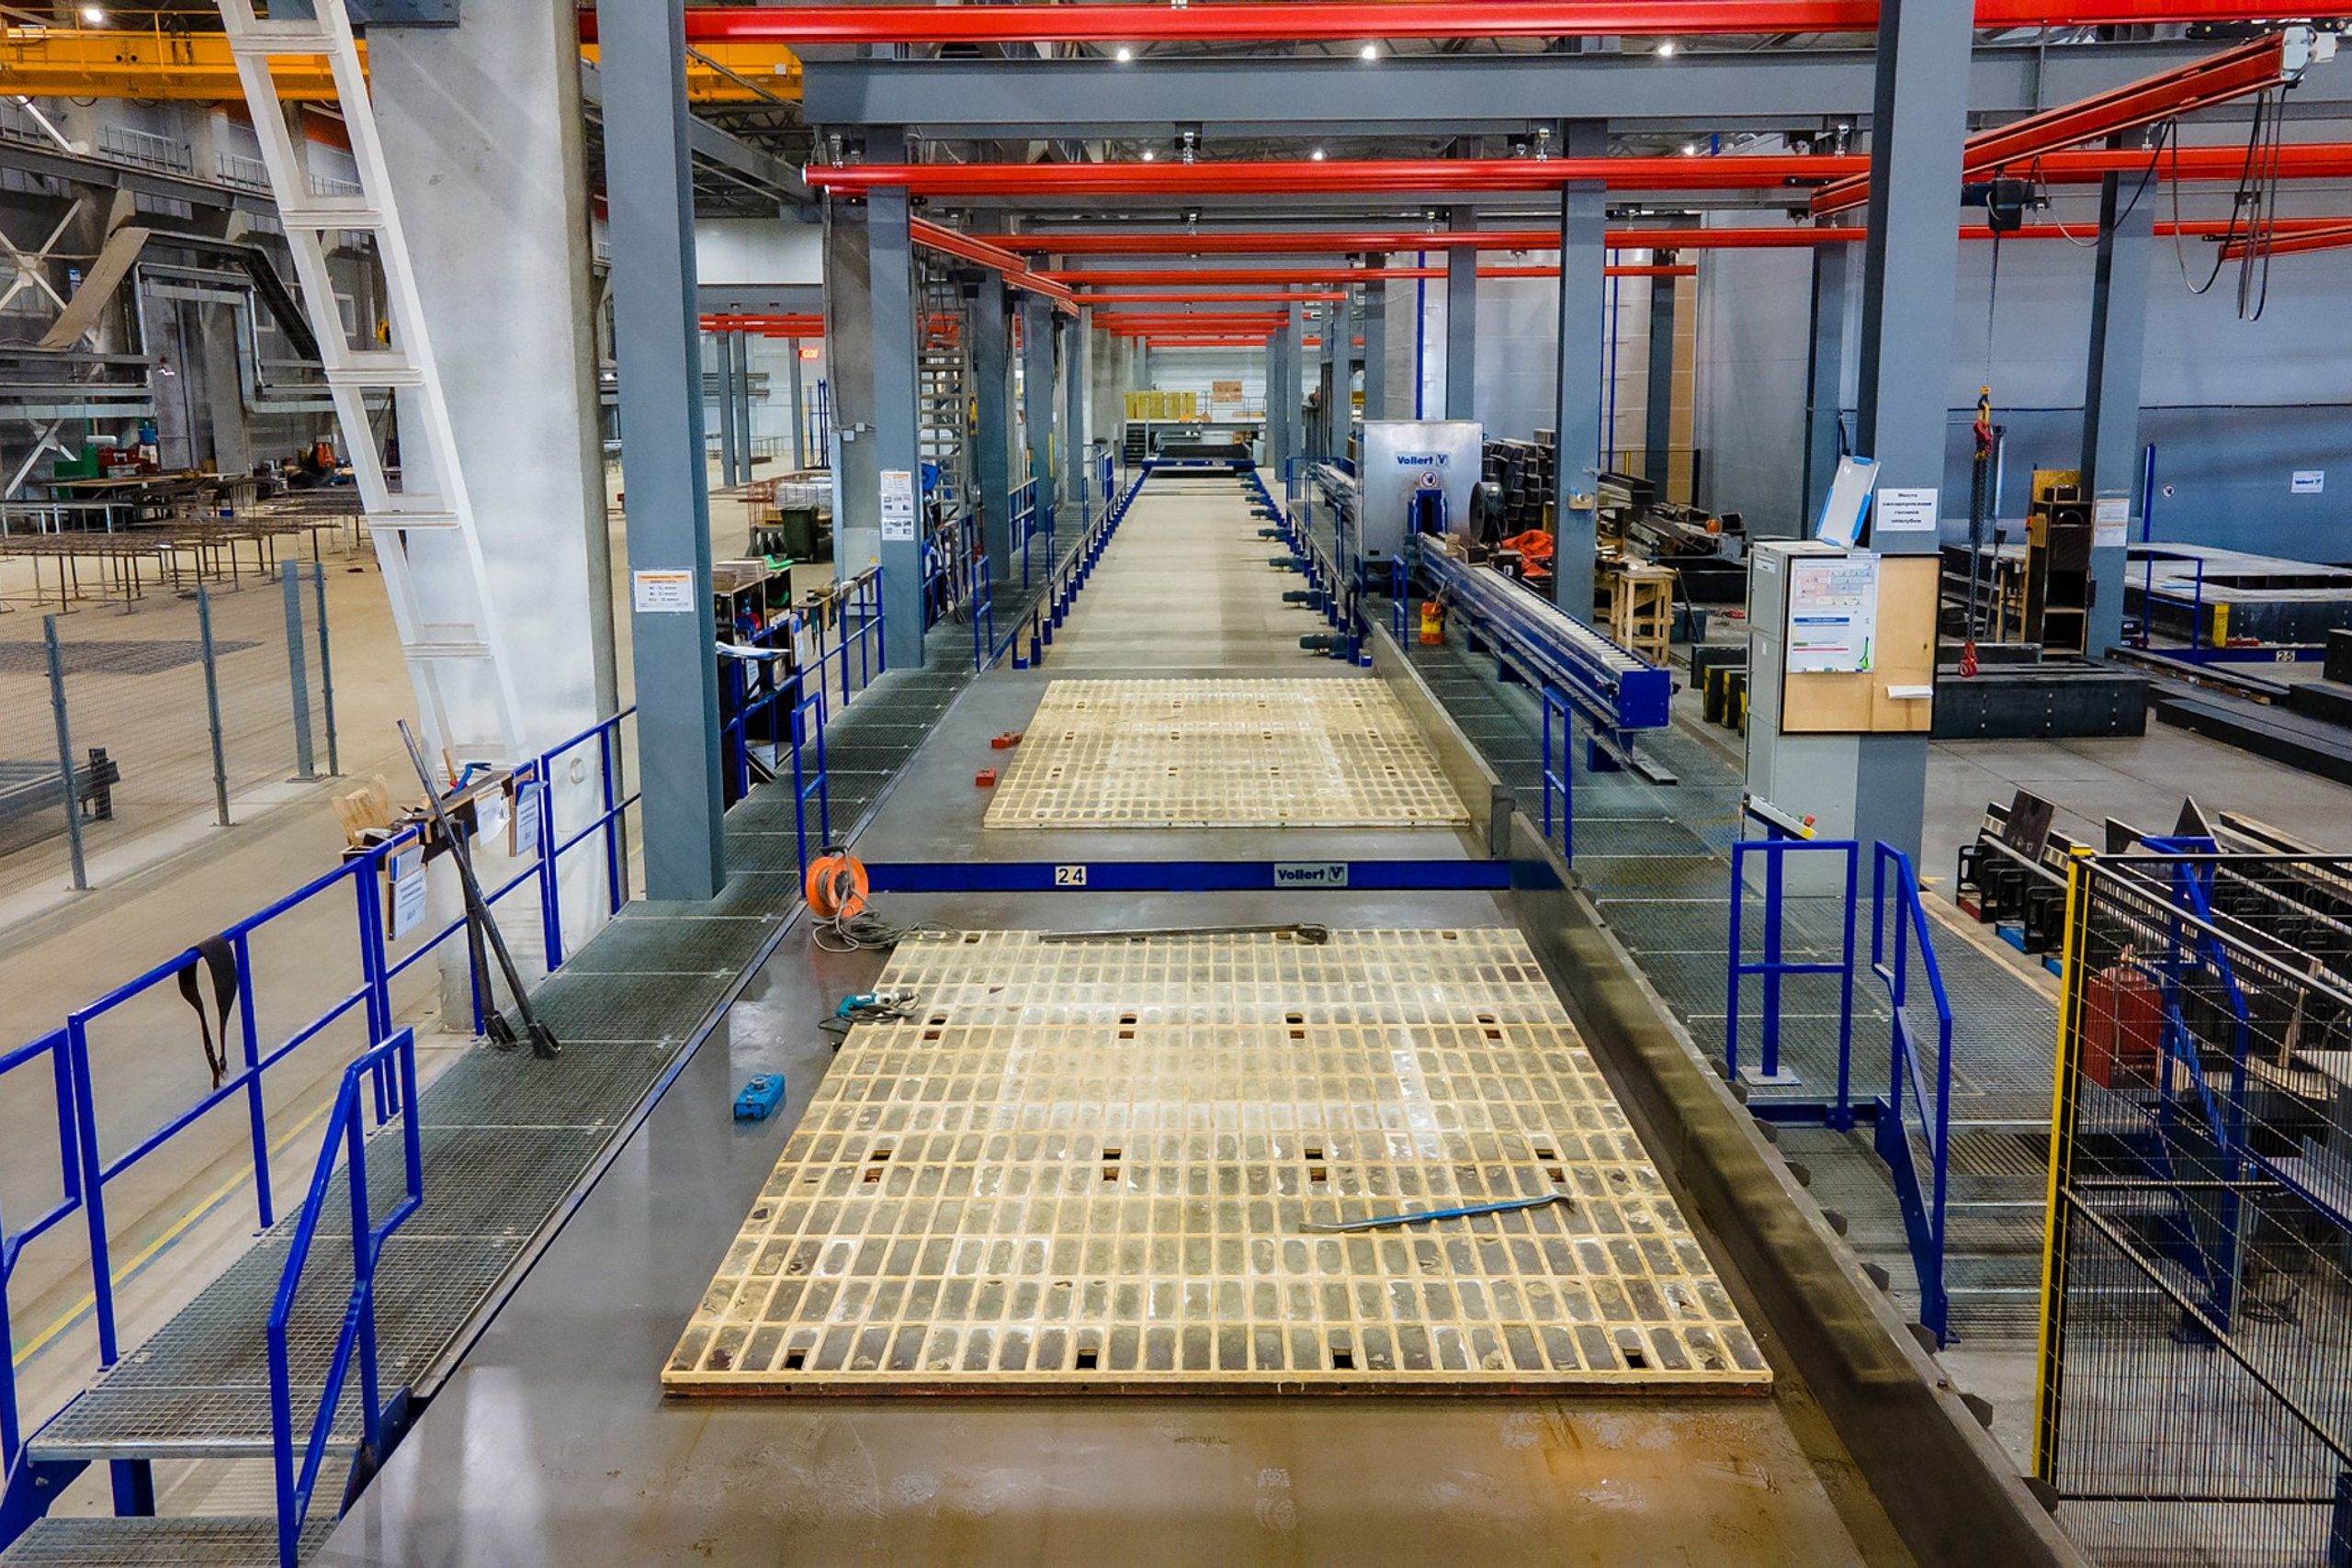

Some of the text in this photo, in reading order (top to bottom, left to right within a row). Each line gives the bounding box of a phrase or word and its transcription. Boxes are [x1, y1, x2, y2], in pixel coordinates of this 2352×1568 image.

[1397, 456, 1433, 465] Vollert
[1057, 868, 1084, 884] 24
[1277, 869, 1326, 880] Vollert
